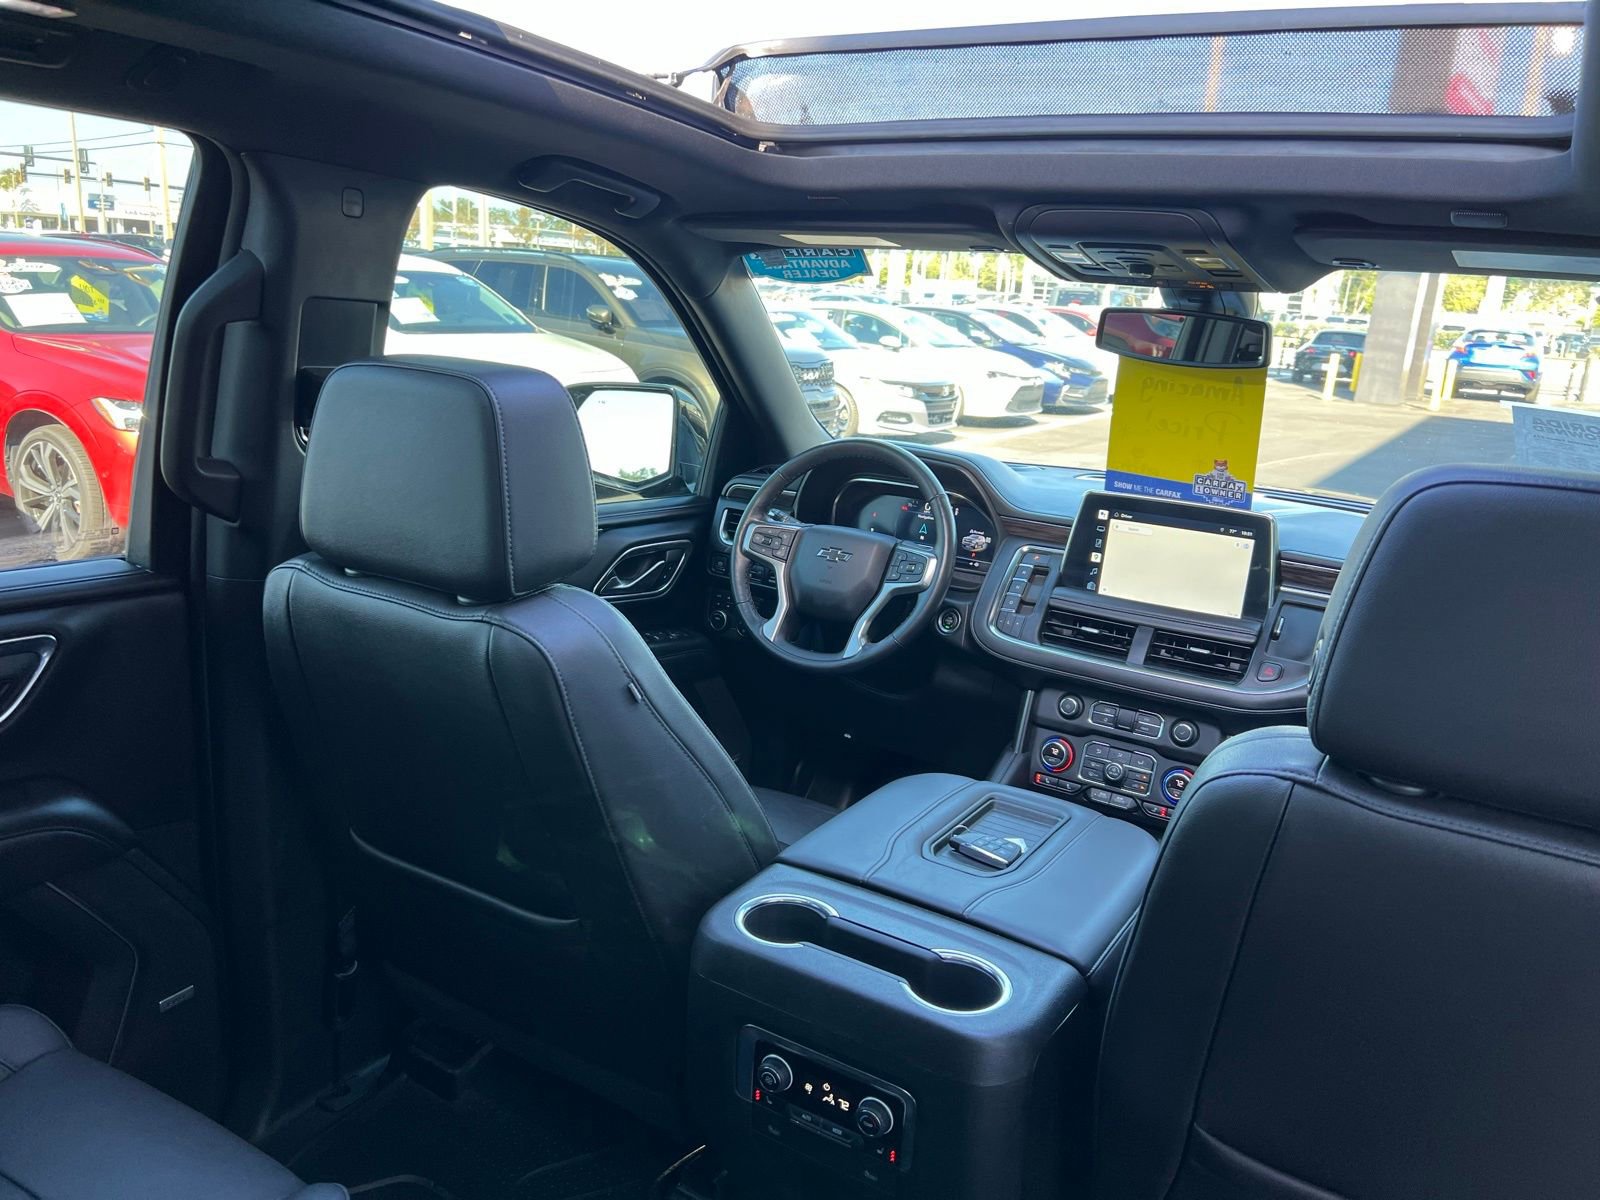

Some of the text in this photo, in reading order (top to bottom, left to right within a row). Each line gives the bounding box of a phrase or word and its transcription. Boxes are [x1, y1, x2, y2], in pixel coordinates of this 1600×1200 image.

[1114, 480, 1181, 499] SHOW ME THE CARFAX
[1197, 477, 1243, 492] CARFAX
[1204, 487, 1242, 499] OWNER
[1051, 747, 1059, 756] 72
[1175, 779, 1184, 788] 72
[837, 1098, 850, 1112] 72
